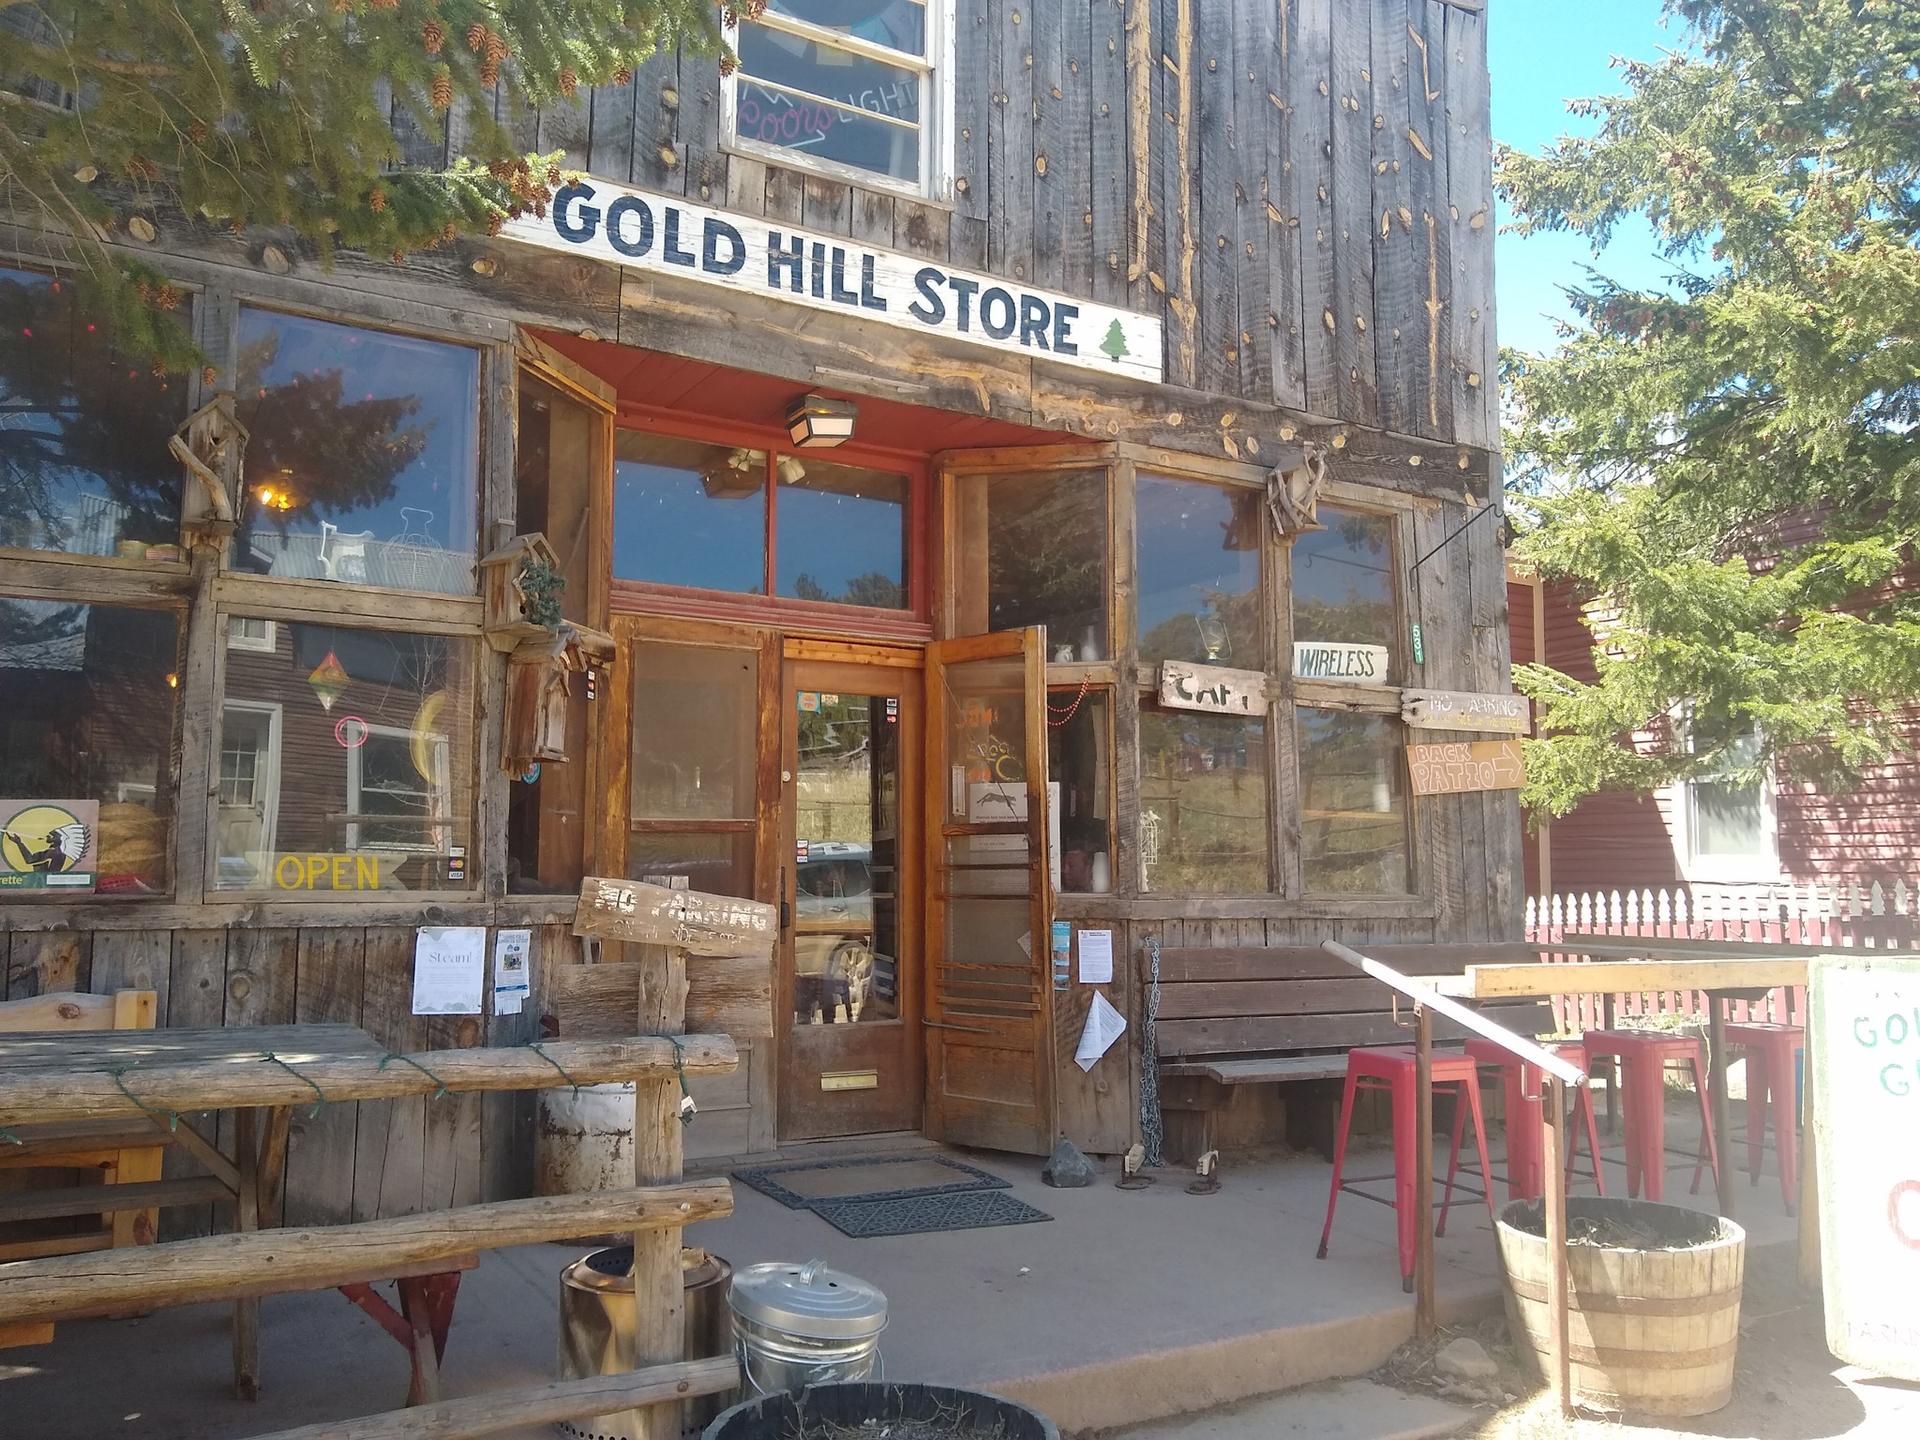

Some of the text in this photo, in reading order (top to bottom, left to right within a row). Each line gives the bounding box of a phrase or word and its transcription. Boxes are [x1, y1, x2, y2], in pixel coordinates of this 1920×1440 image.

[552, 181, 1079, 356] GOLD HILL STORE
[1299, 647, 1376, 678] WIRELESS
[1415, 743, 1472, 762] BACK
[1412, 762, 1495, 793] PATIO
[275, 855, 380, 890] OPEN
